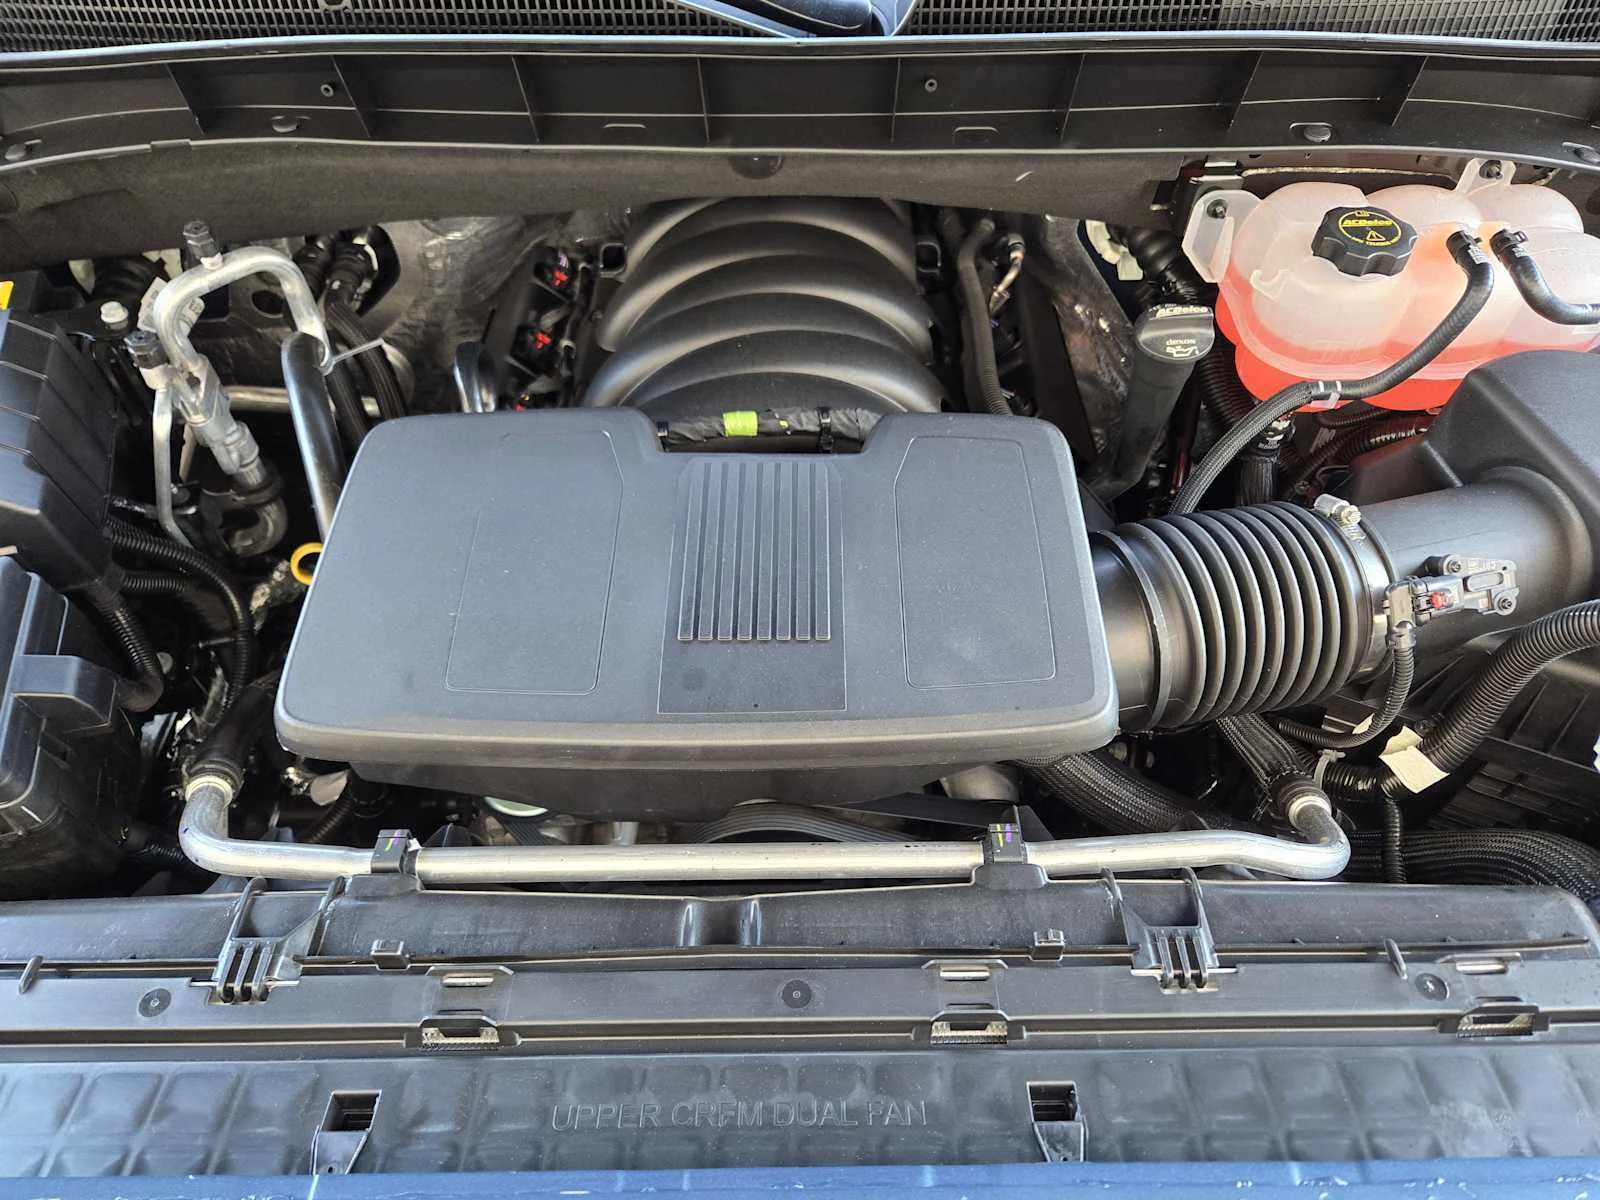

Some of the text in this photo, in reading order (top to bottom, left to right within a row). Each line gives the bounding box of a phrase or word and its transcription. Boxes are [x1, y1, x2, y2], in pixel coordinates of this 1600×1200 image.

[1342, 219, 1394, 227] ACDelco
[552, 1098, 928, 1131] UPPER CRFM DUAL FAN
